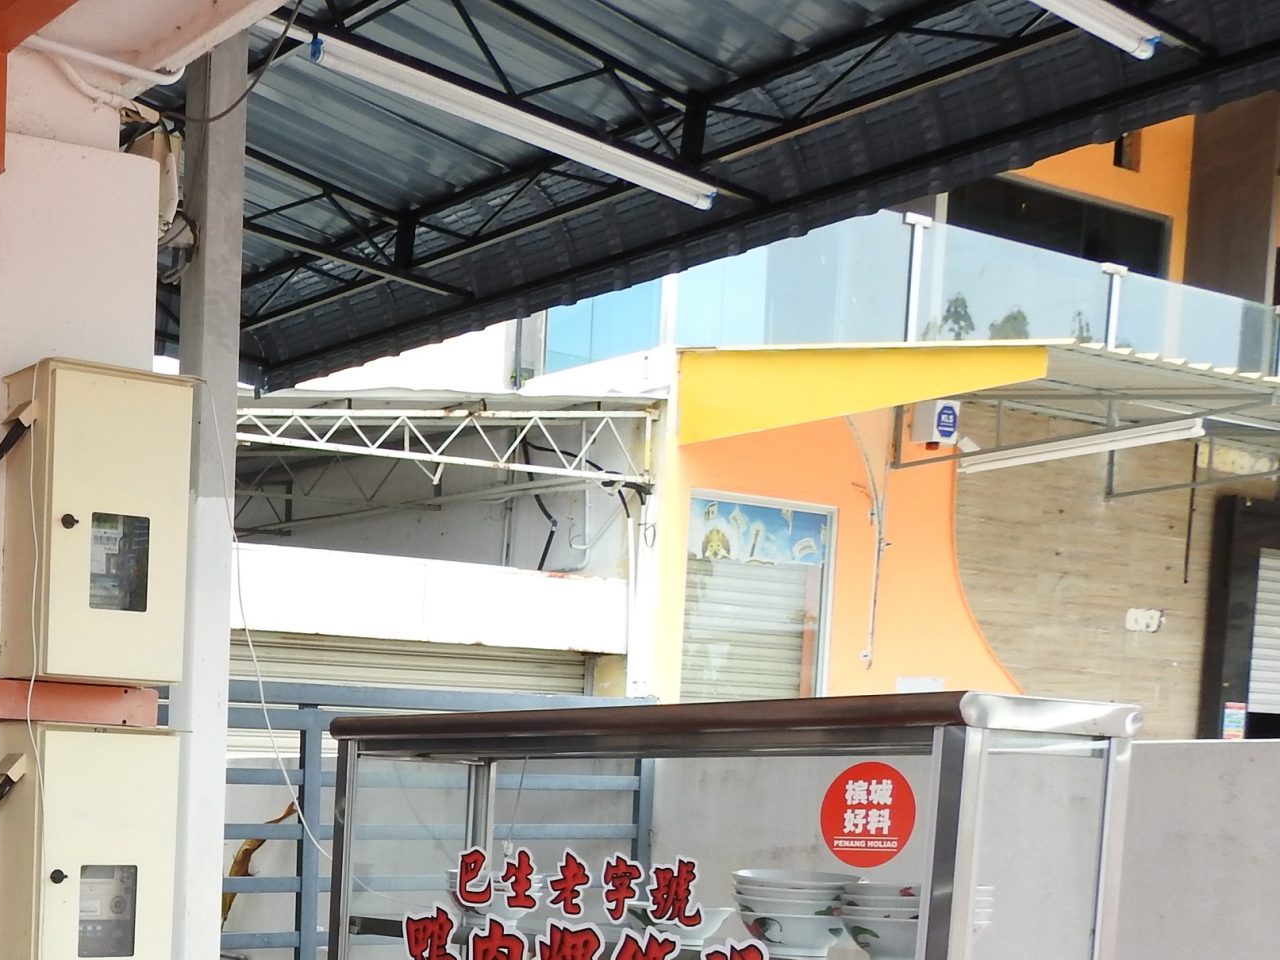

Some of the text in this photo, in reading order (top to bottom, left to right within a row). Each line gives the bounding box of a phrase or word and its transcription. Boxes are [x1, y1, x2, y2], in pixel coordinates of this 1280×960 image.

[842, 808, 891, 834] 好料
[833, 839, 898, 849] PENANG HOLIAO
[458, 849, 702, 928] 巴生老字號
